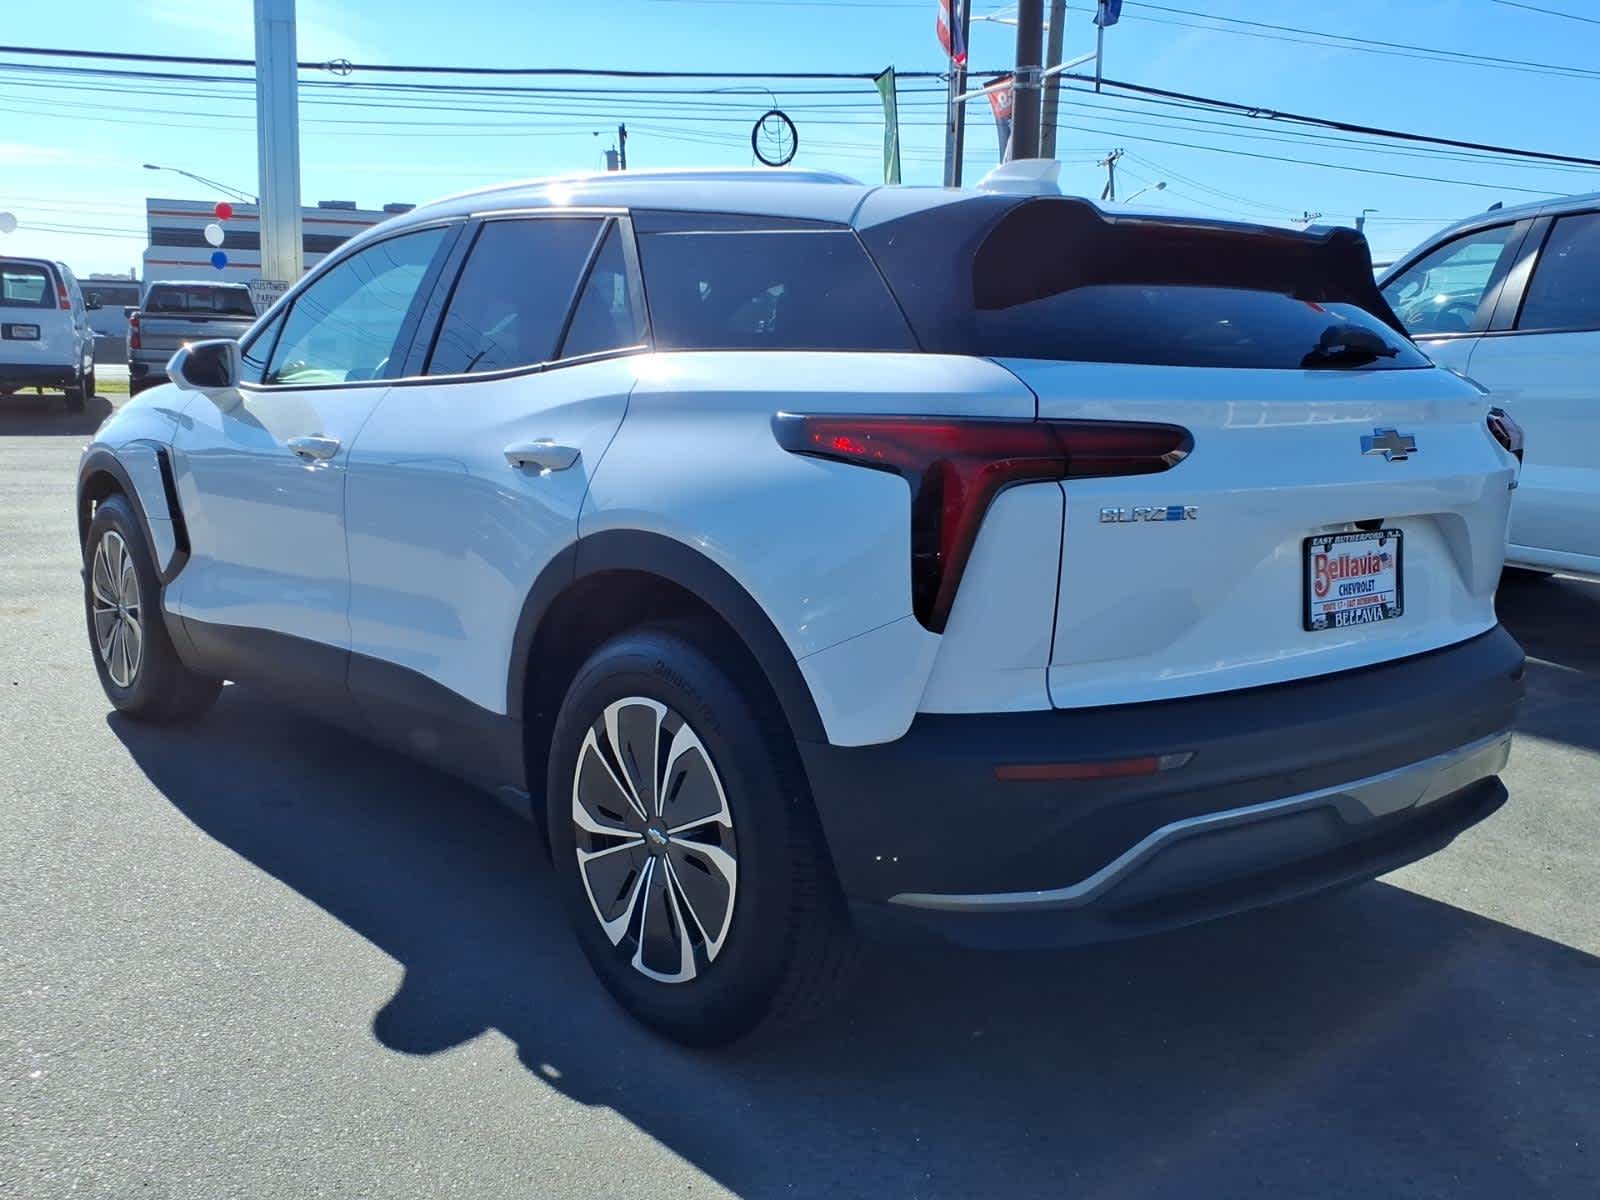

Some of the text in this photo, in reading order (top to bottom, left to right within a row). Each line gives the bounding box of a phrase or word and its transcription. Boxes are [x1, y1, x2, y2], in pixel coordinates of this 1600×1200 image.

[1100, 505, 1199, 523] BLAZER
[1313, 537, 1334, 546] EAST
[1314, 552, 1381, 597] Bellavia
[1338, 579, 1375, 596] CHEVROLET
[1336, 607, 1384, 627] BELLAVIA
